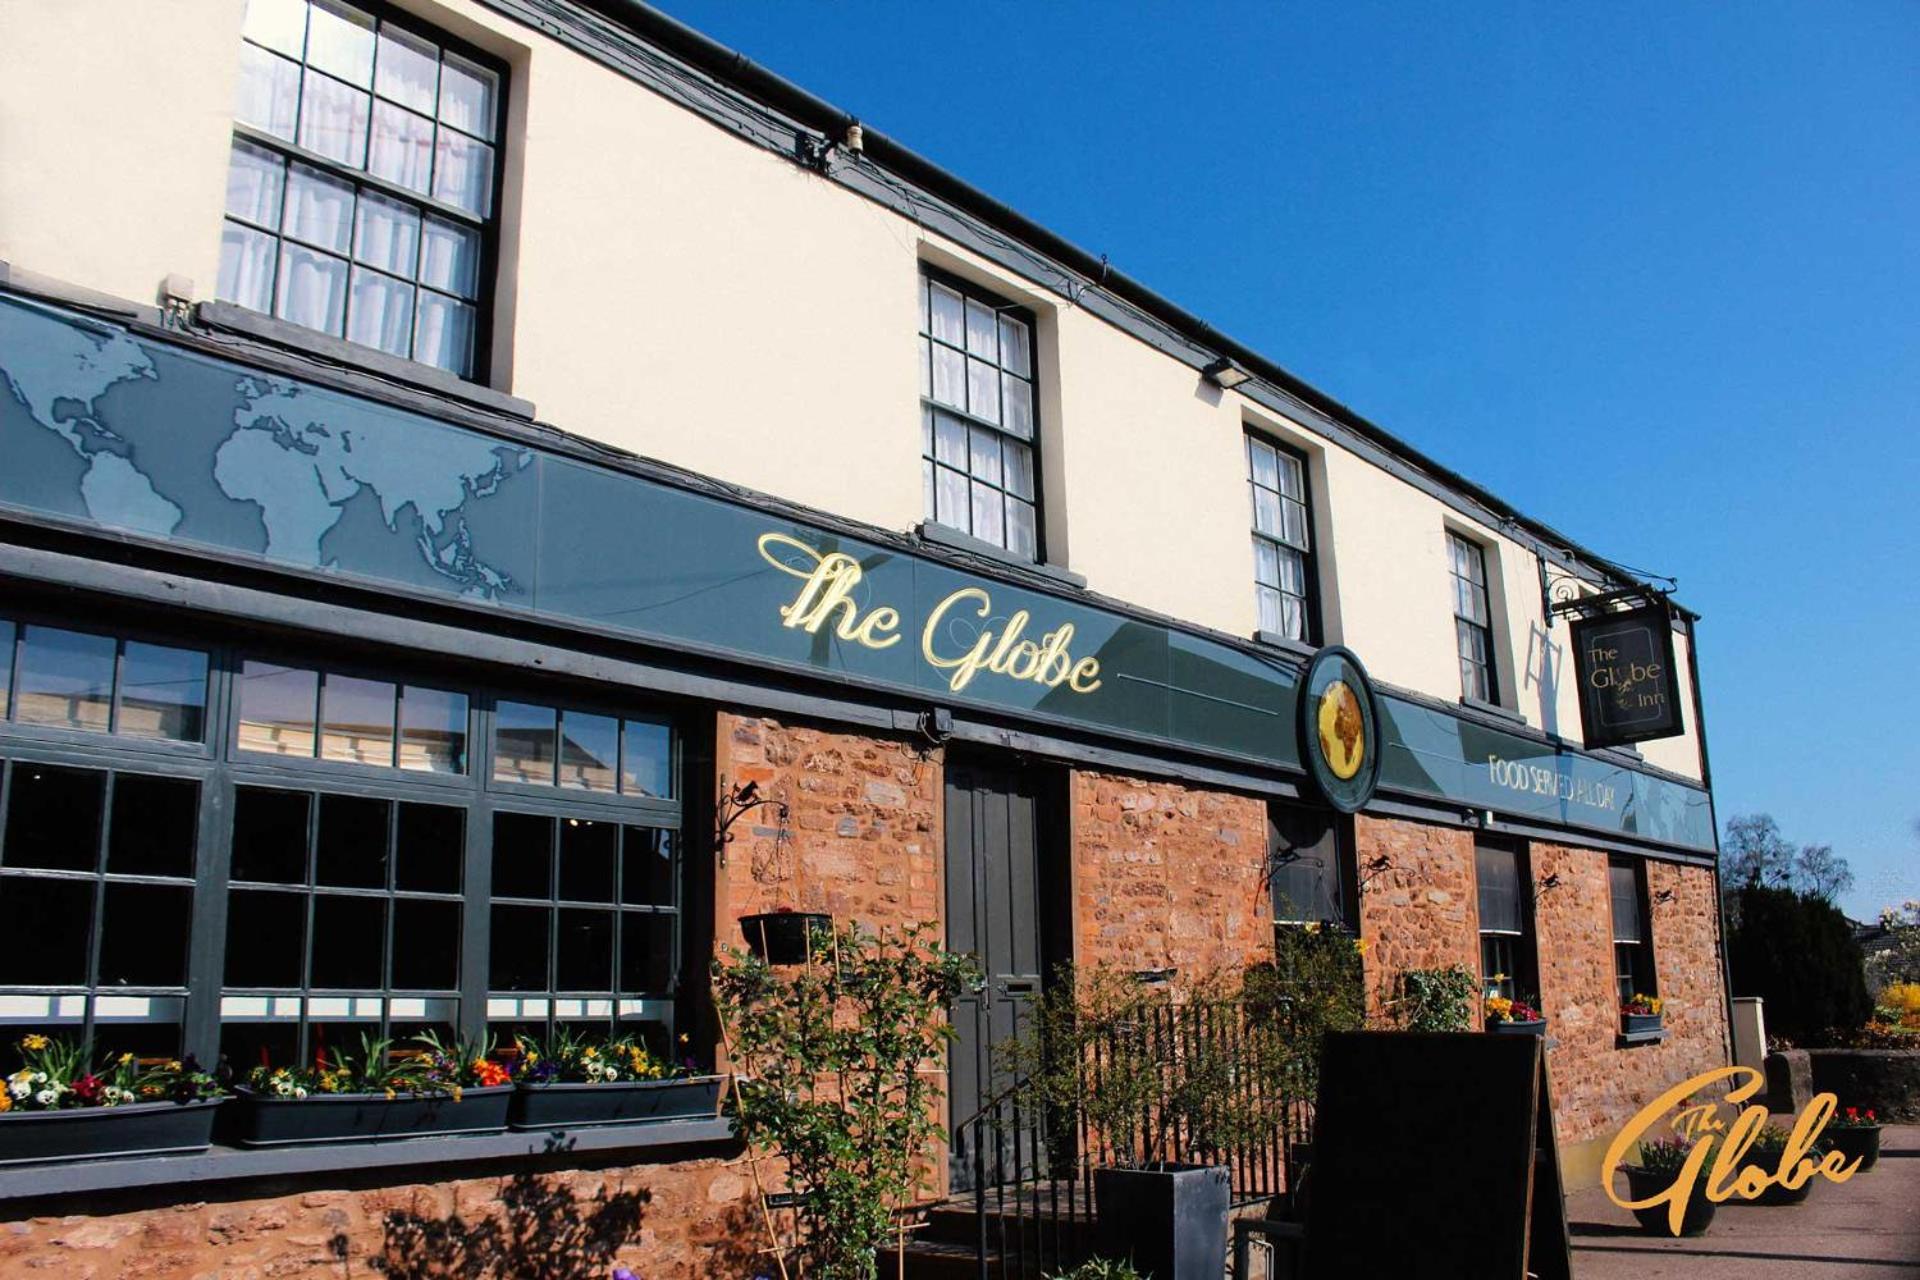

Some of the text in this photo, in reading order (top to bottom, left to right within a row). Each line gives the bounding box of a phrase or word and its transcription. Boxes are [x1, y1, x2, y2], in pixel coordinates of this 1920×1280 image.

[758, 533, 1102, 693] The Globe
[1588, 647, 1619, 663] The
[1590, 662, 1661, 689] Glbe
[1638, 692, 1664, 707] Inn
[1488, 754, 1529, 790] FOOD
